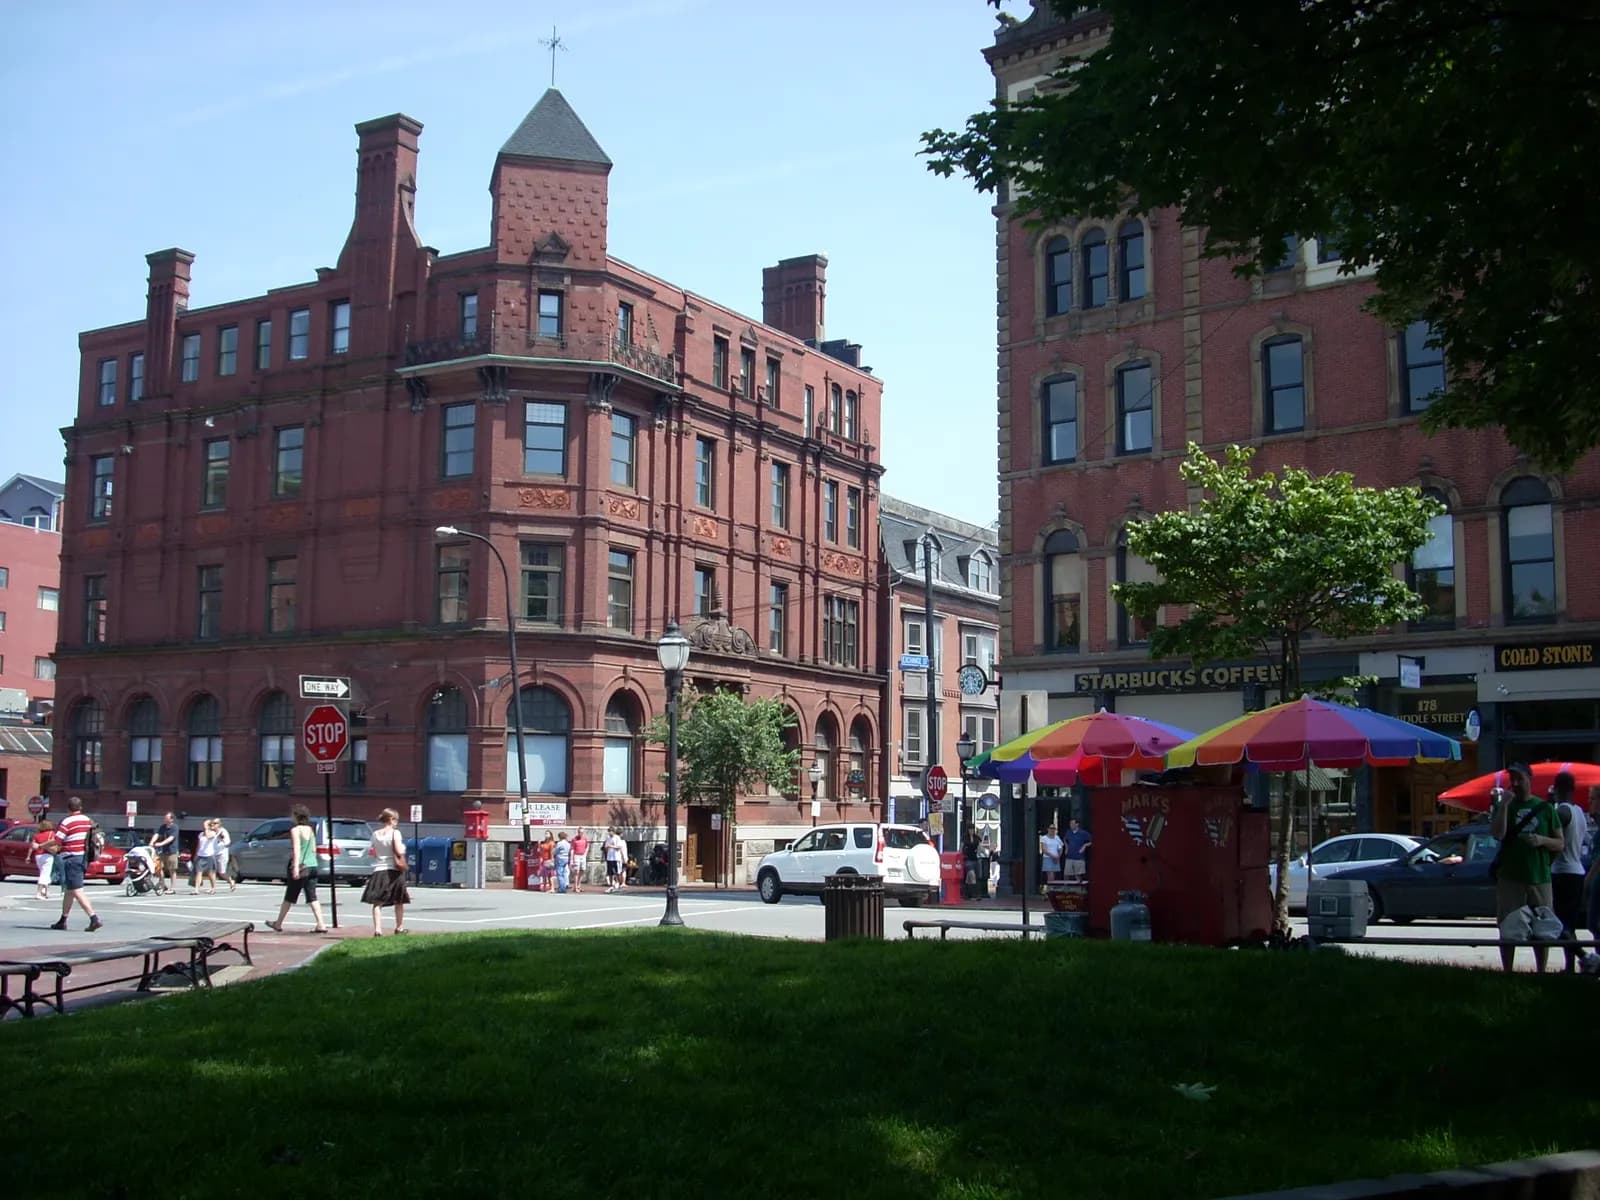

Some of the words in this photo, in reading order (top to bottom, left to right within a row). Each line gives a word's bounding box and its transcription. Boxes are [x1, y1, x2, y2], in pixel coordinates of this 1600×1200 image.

[1501, 647, 1540, 666] COLD
[1543, 645, 1592, 664] STONE
[1078, 669, 1196, 690] STARBUCKS
[306, 683, 320, 692] ONE
[326, 684, 340, 692] WAY
[1417, 699, 1438, 712] 178
[1397, 712, 1430, 724] IDDLE
[1431, 712, 1465, 724] STREET
[307, 722, 345, 744] STOP
[928, 776, 947, 791] STOP
